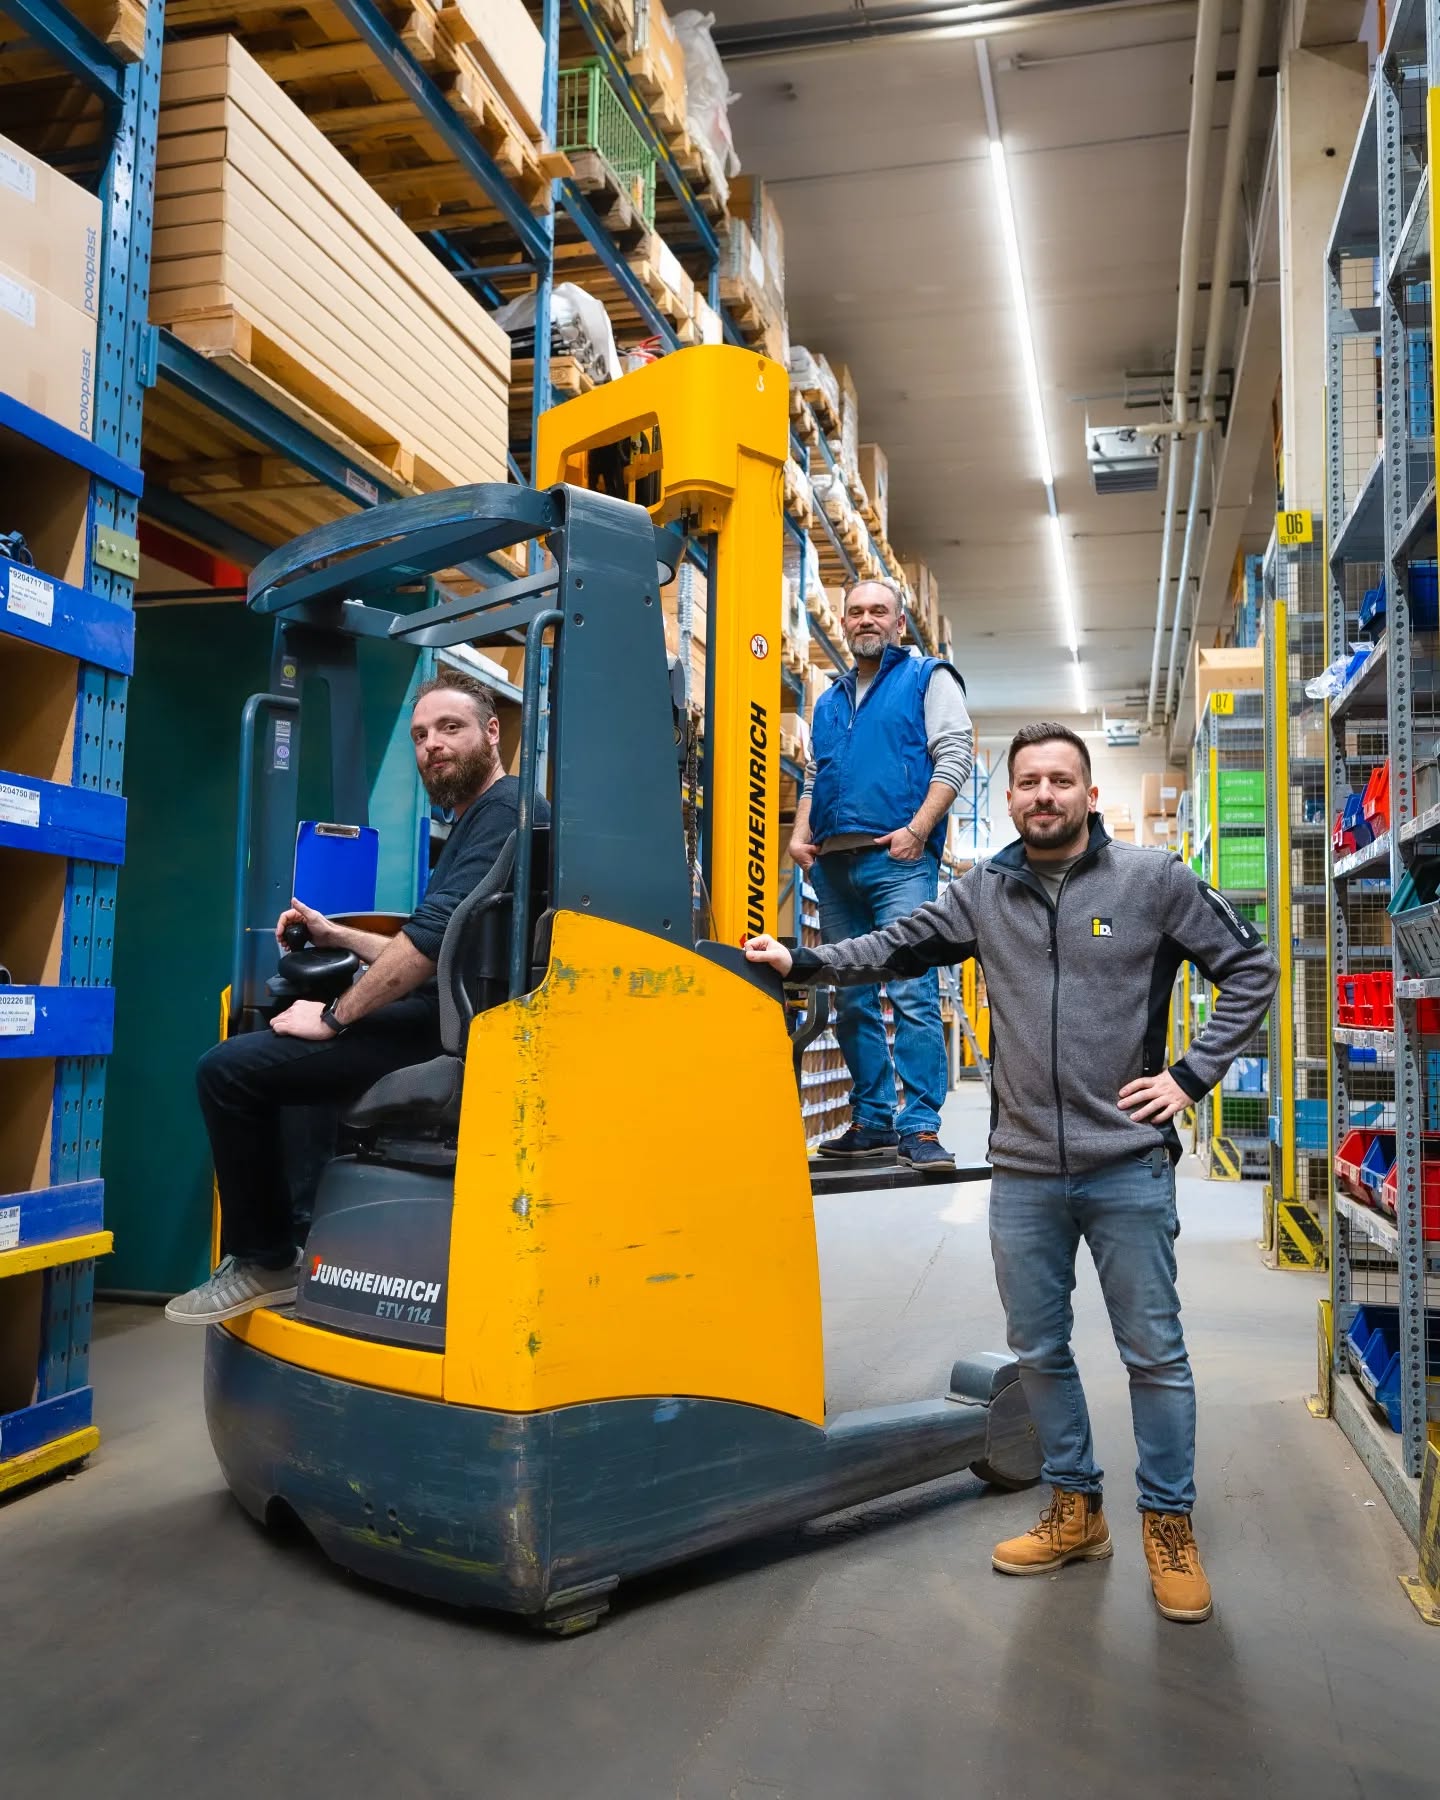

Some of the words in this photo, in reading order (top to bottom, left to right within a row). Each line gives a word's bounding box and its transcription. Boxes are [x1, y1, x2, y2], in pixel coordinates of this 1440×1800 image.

[84, 227, 97, 313] poloplast
[79, 348, 92, 435] poloplast
[1286, 513, 1303, 535] 06
[12, 570, 42, 588] 9204717
[1216, 693, 1229, 709] 07
[310, 1261, 441, 1303] JUNGHEINRICH
[375, 1300, 405, 1319] ETV
[407, 1305, 431, 1324] 114
